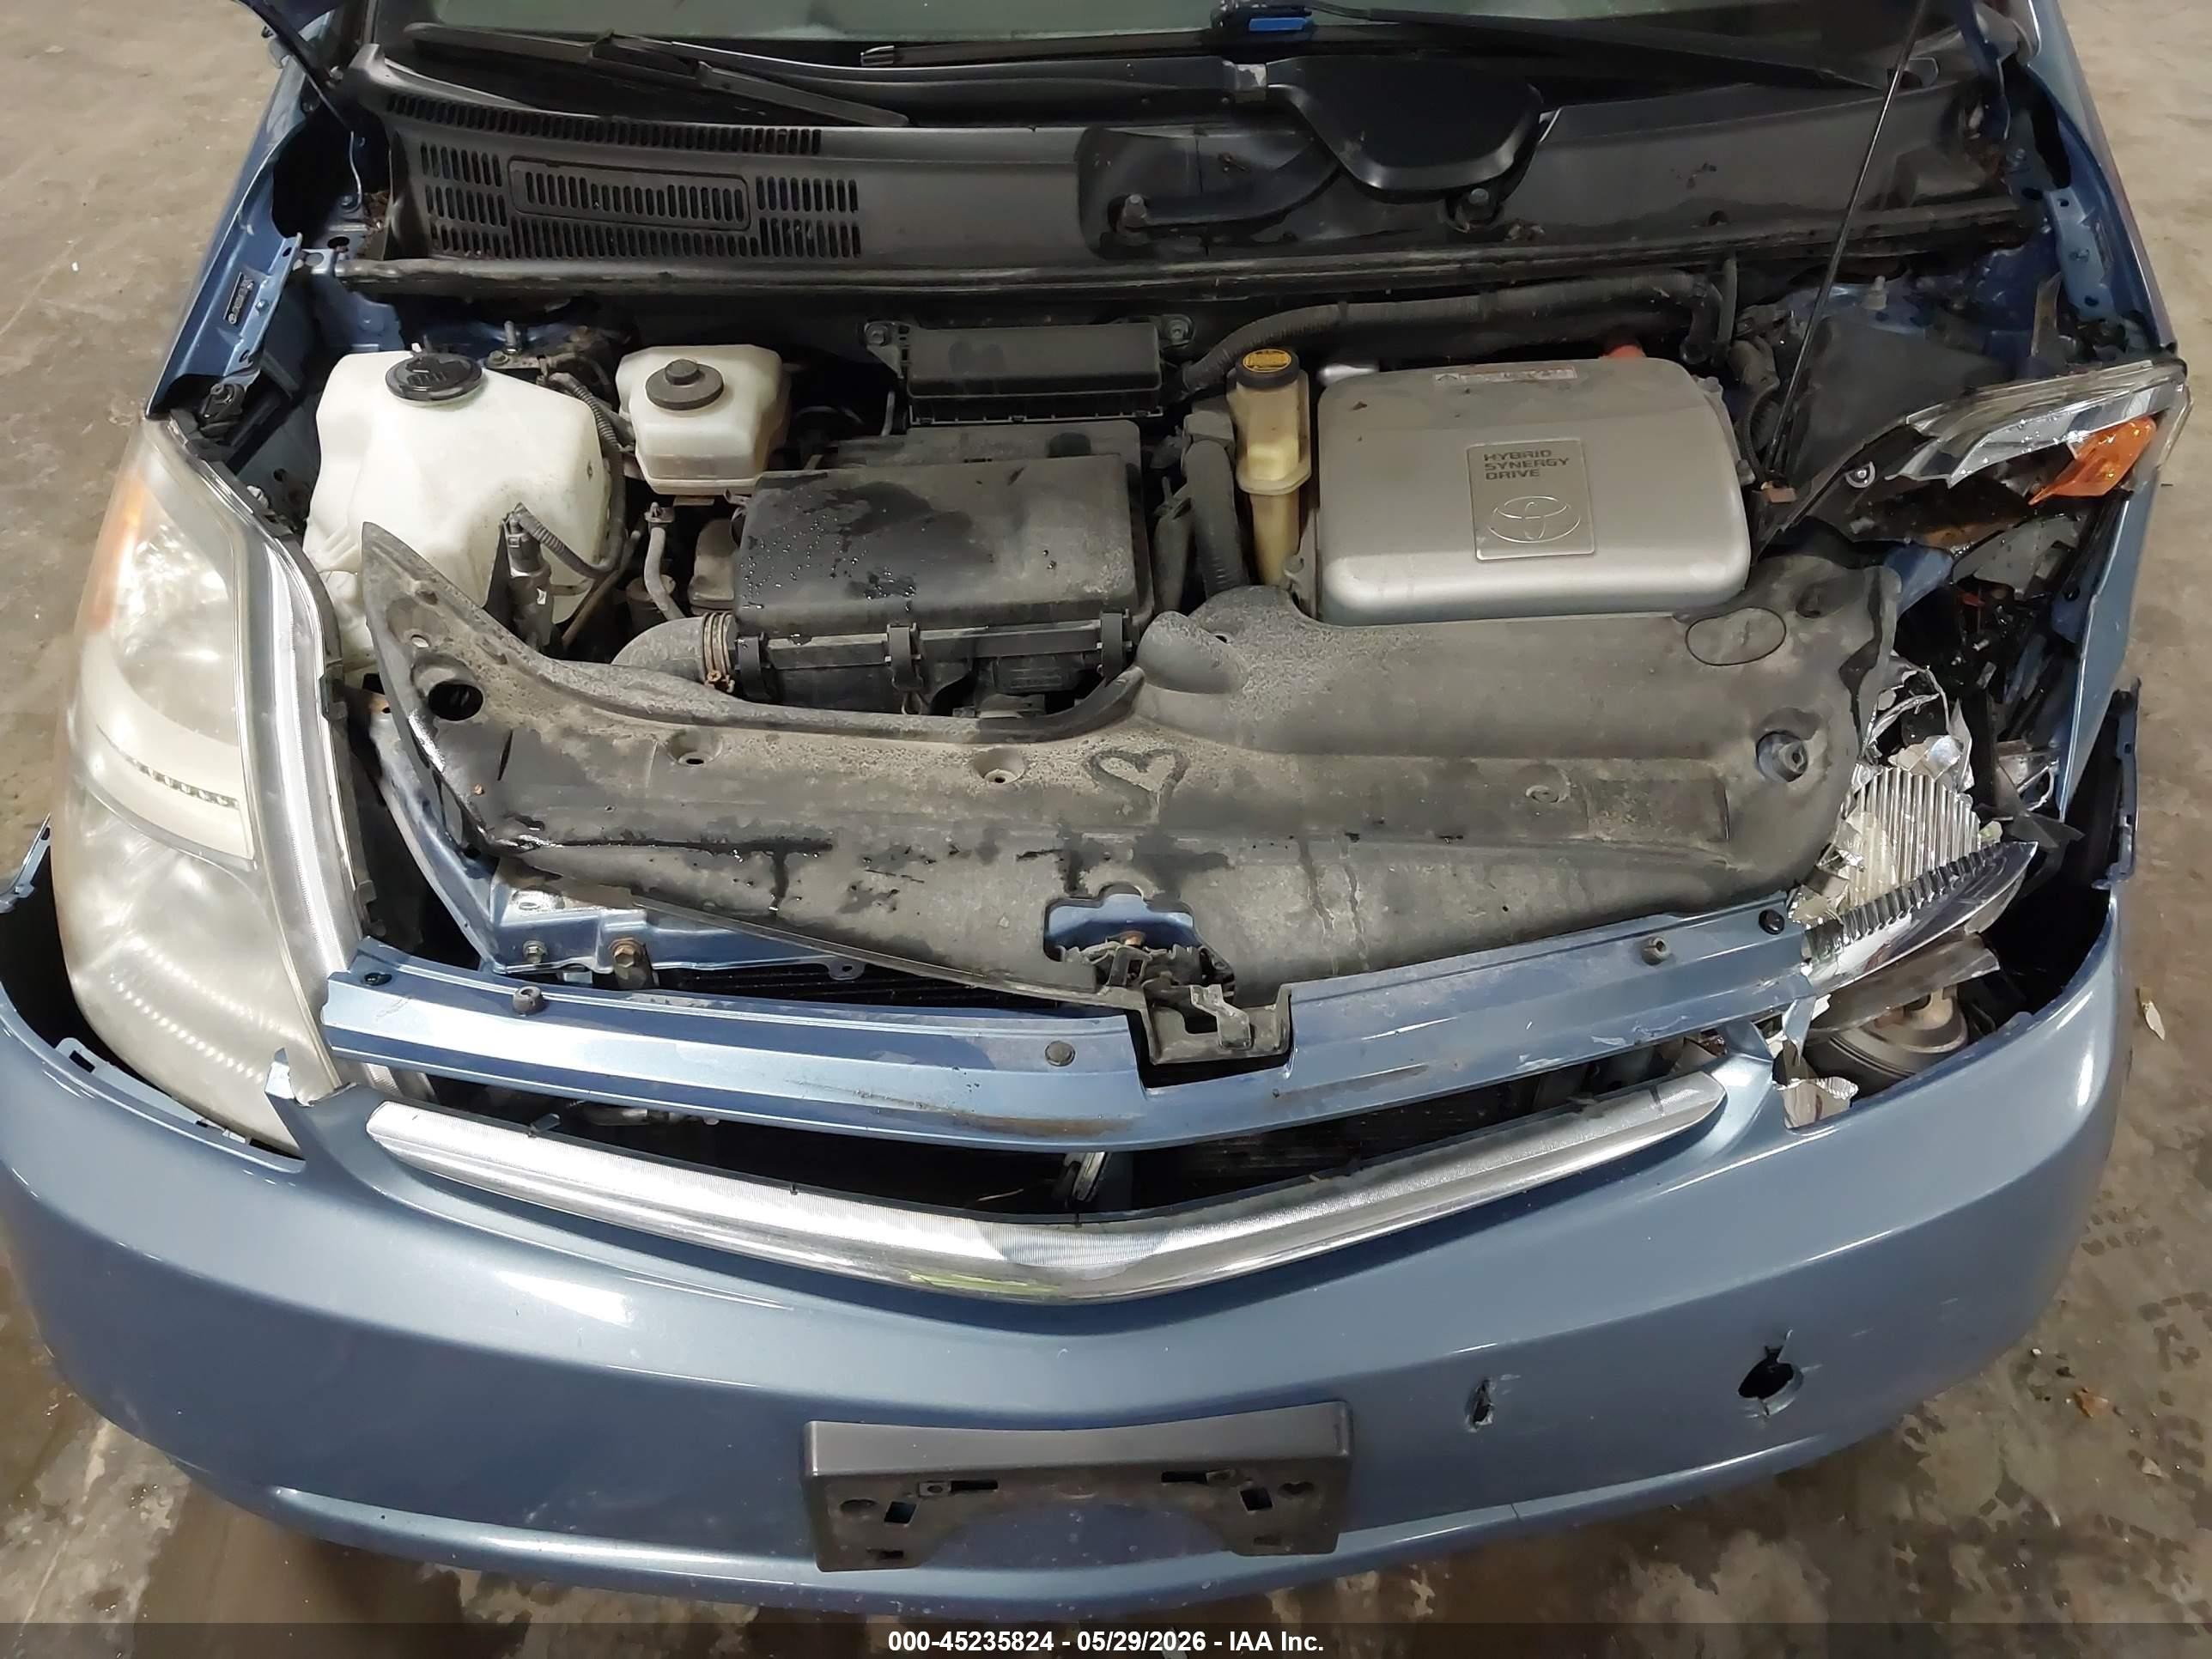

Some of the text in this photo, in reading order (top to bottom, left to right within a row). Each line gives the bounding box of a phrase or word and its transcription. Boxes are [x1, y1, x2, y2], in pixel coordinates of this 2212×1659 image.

[1483, 449, 1553, 461] HYBRID
[1484, 458, 1569, 471] SYNERGY
[1486, 469, 1540, 480] DRIVE
